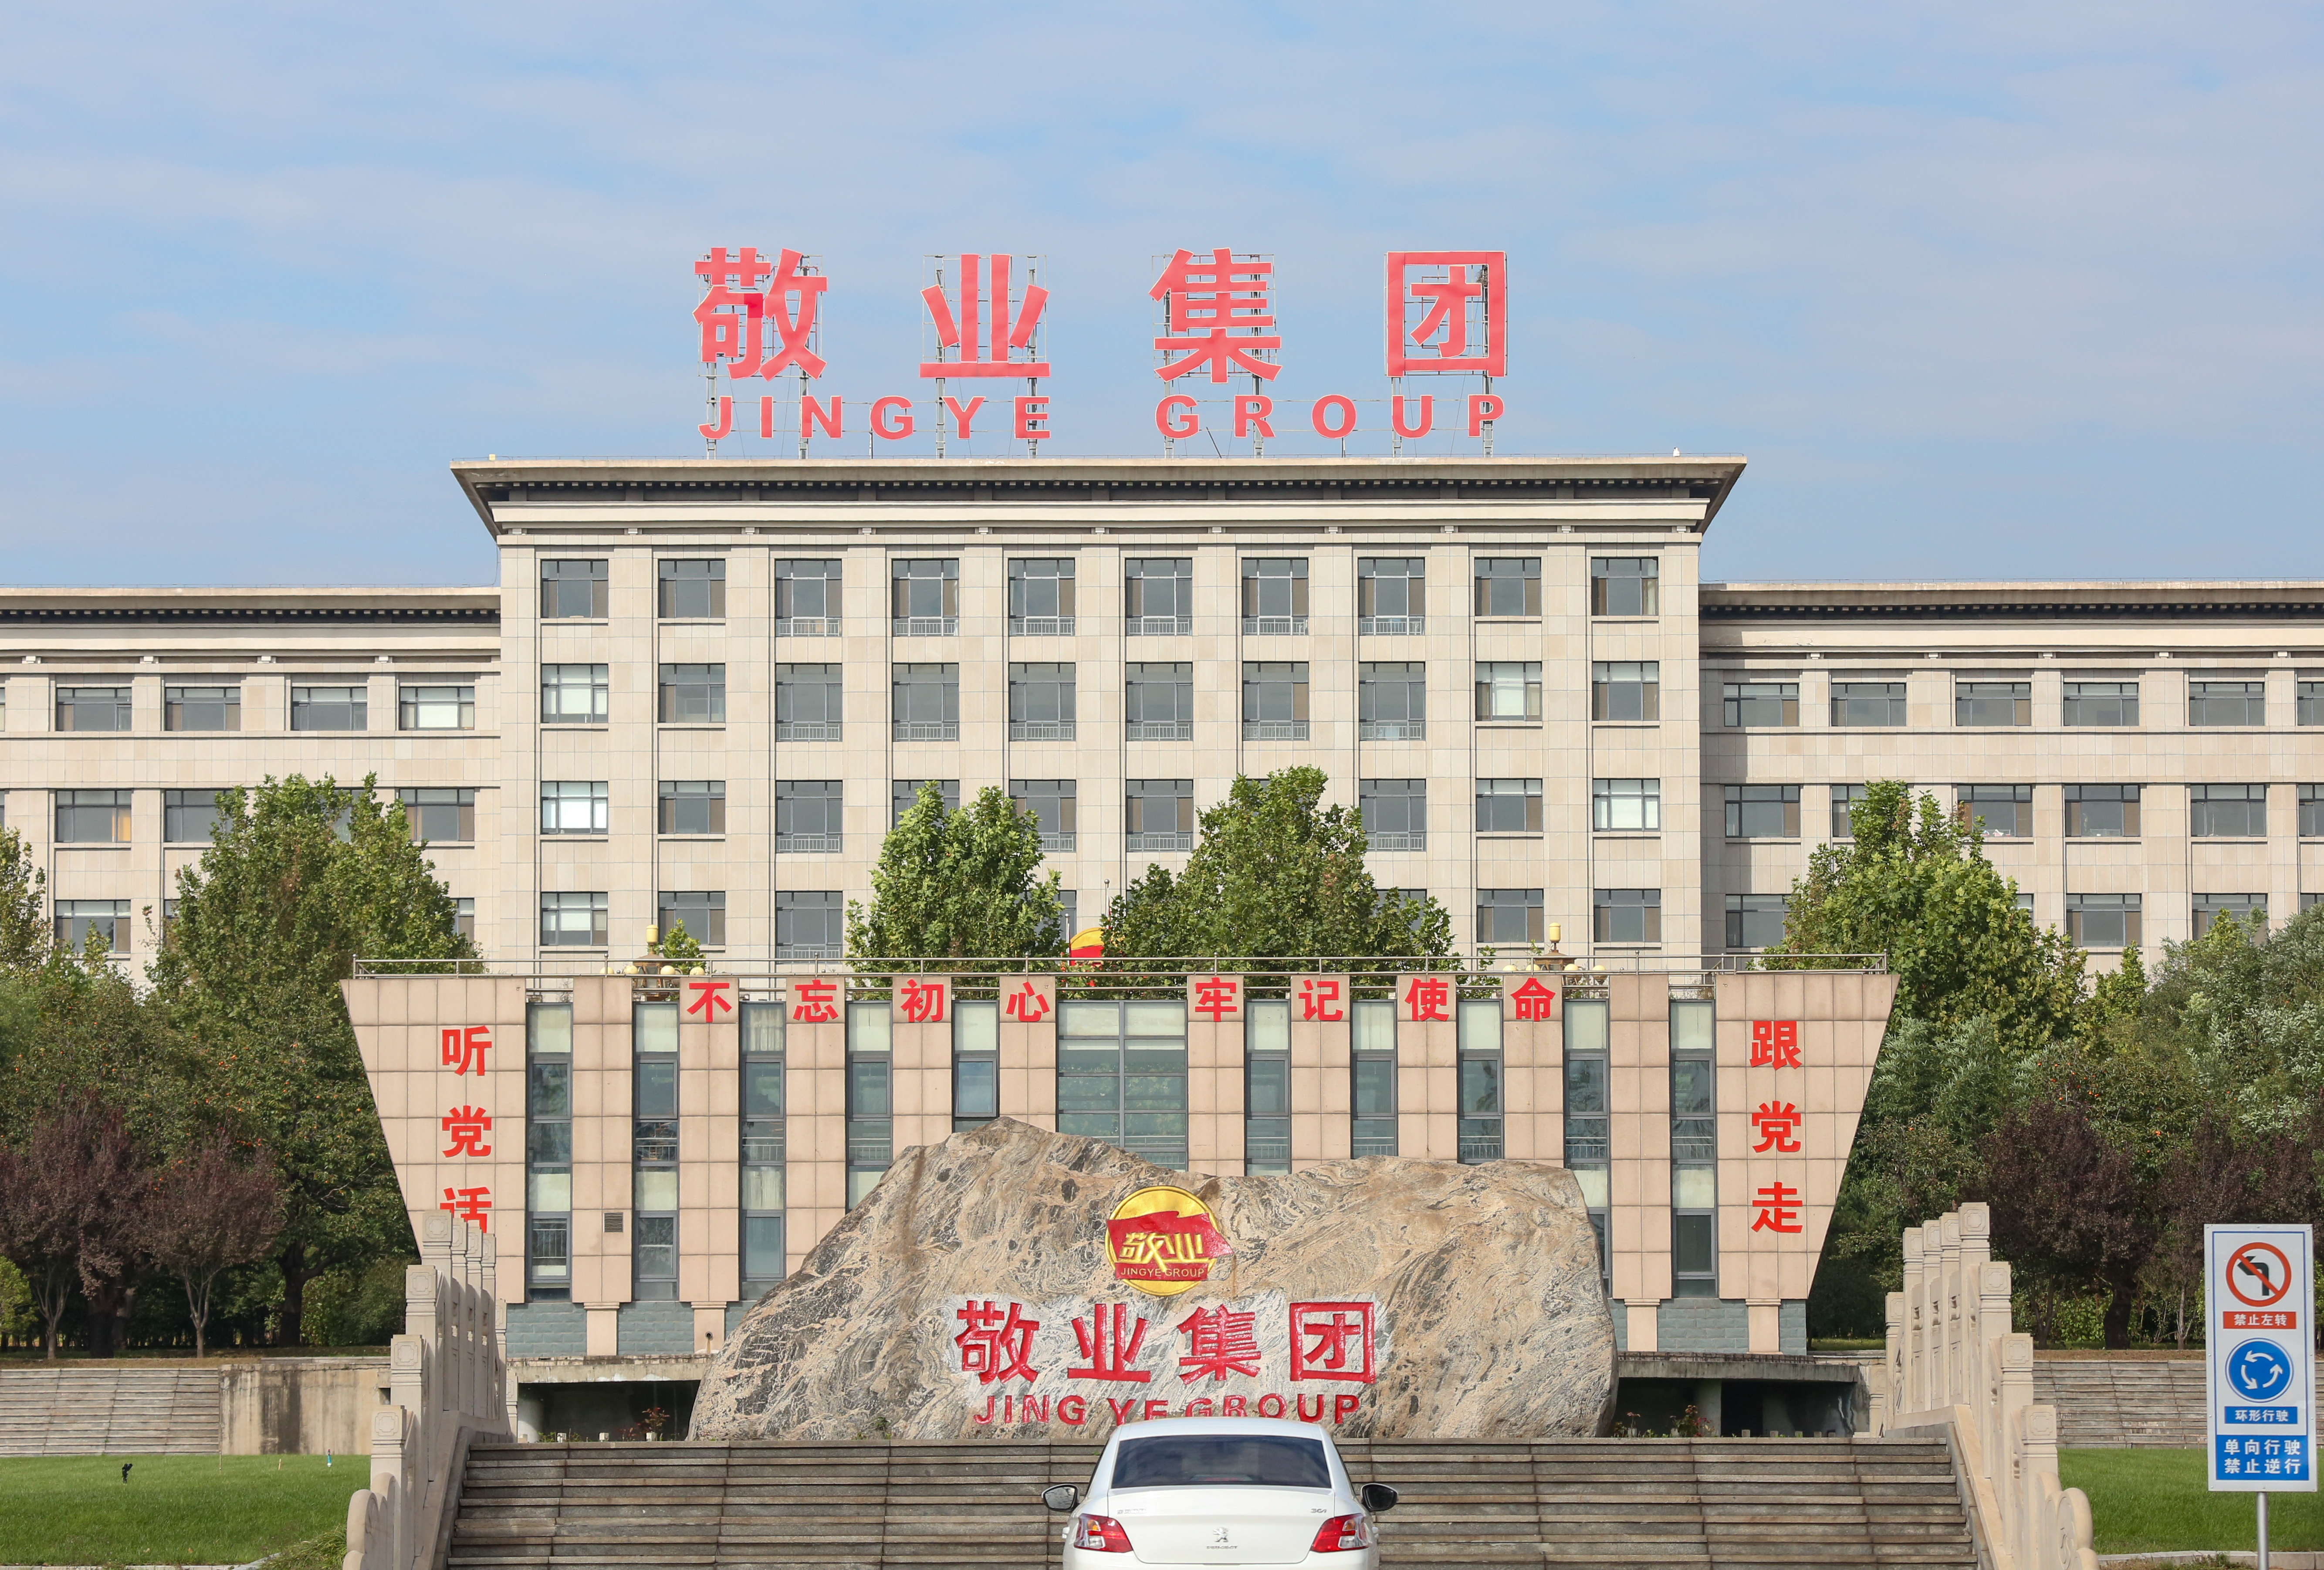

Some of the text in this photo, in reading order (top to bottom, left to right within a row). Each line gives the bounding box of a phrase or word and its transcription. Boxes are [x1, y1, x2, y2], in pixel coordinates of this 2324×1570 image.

[693, 247, 1506, 383] 敬业集团
[698, 394, 1505, 440] JINGYE GROUP
[687, 977, 1556, 1023] 不忘初心 牢记使命
[1749, 1020, 1803, 1233] 跟党走
[1119, 1232, 1209, 1272] 敬业
[1121, 1268, 1204, 1278] JINGYE GROUP
[2234, 1314, 2287, 1326] 禁止左转
[955, 1300, 1377, 1385] 敬业集团
[1184, 1394, 1360, 1425] GROUP
[2235, 1410, 2288, 1422] 环形行驶
[2224, 1439, 2300, 1455] 单向行驶
[2225, 1458, 2301, 1474] 禁止逆行
